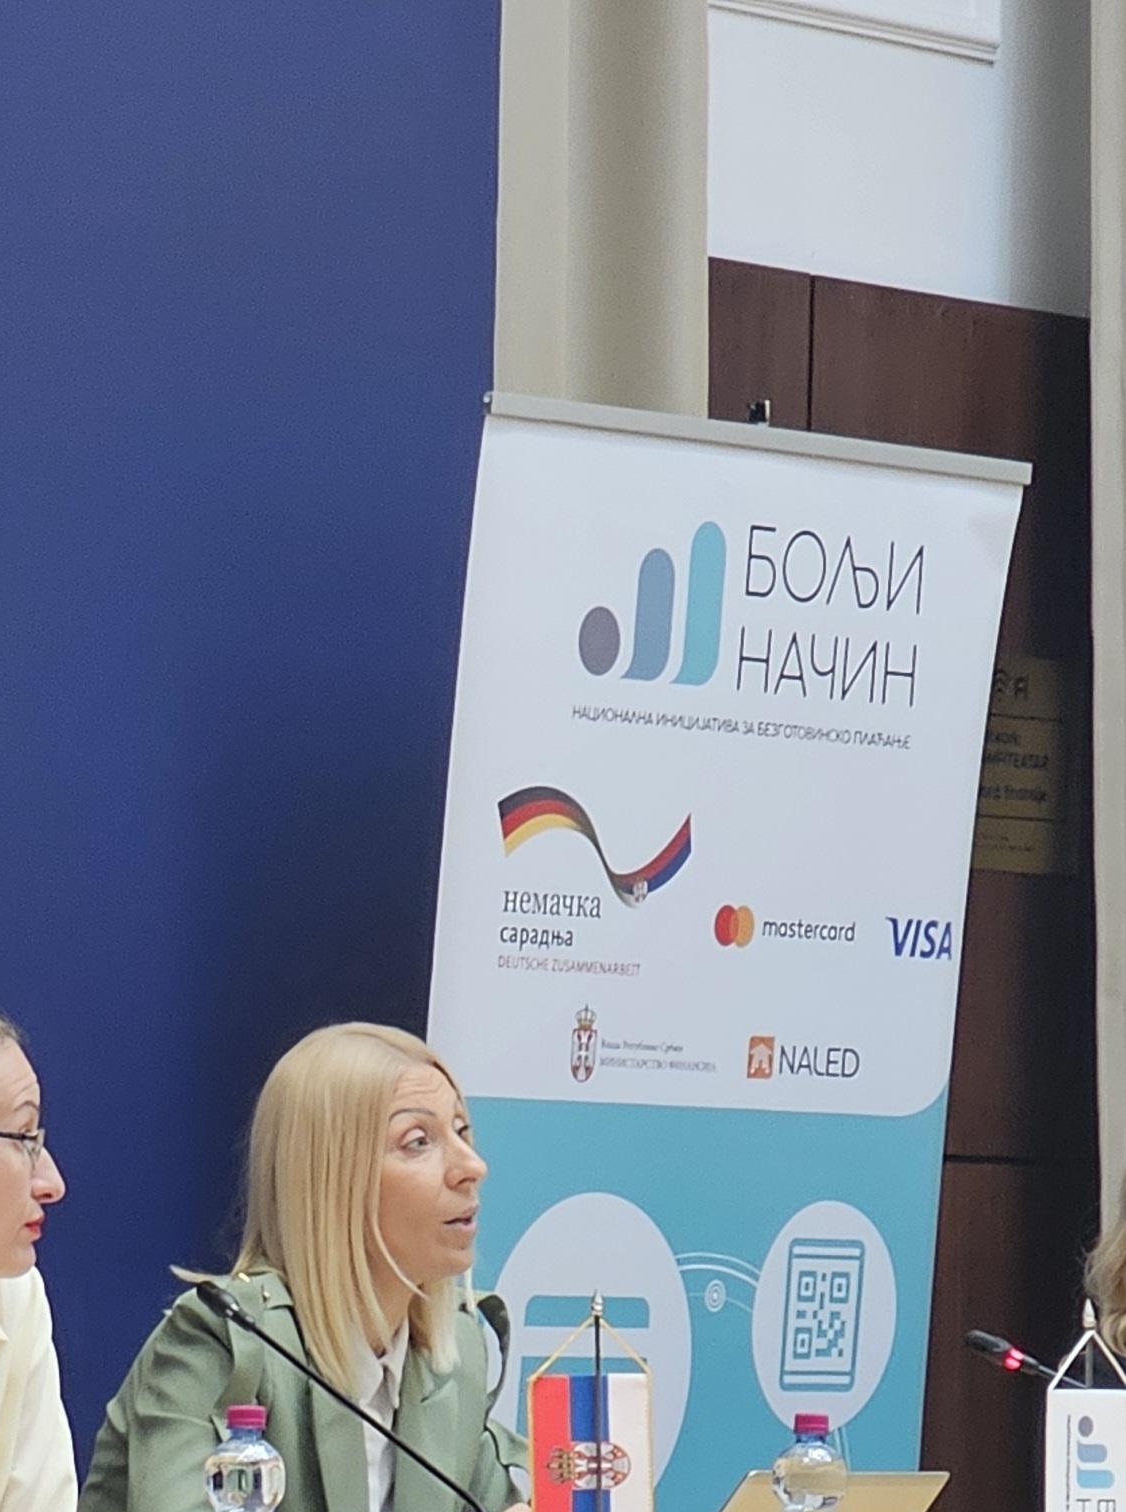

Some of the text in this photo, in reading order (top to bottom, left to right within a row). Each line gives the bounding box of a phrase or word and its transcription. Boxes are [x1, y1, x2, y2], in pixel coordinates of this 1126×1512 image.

[745, 524, 924, 614] БОЉИ
[736, 626, 918, 707] НАЧИН
[503, 890, 602, 919] немачка
[500, 926, 574, 951] сарадња
[762, 919, 857, 943] mastercard
[886, 916, 953, 961] VISA
[497, 954, 549, 973] DEUTSCHE
[779, 1044, 861, 1078] NALED
